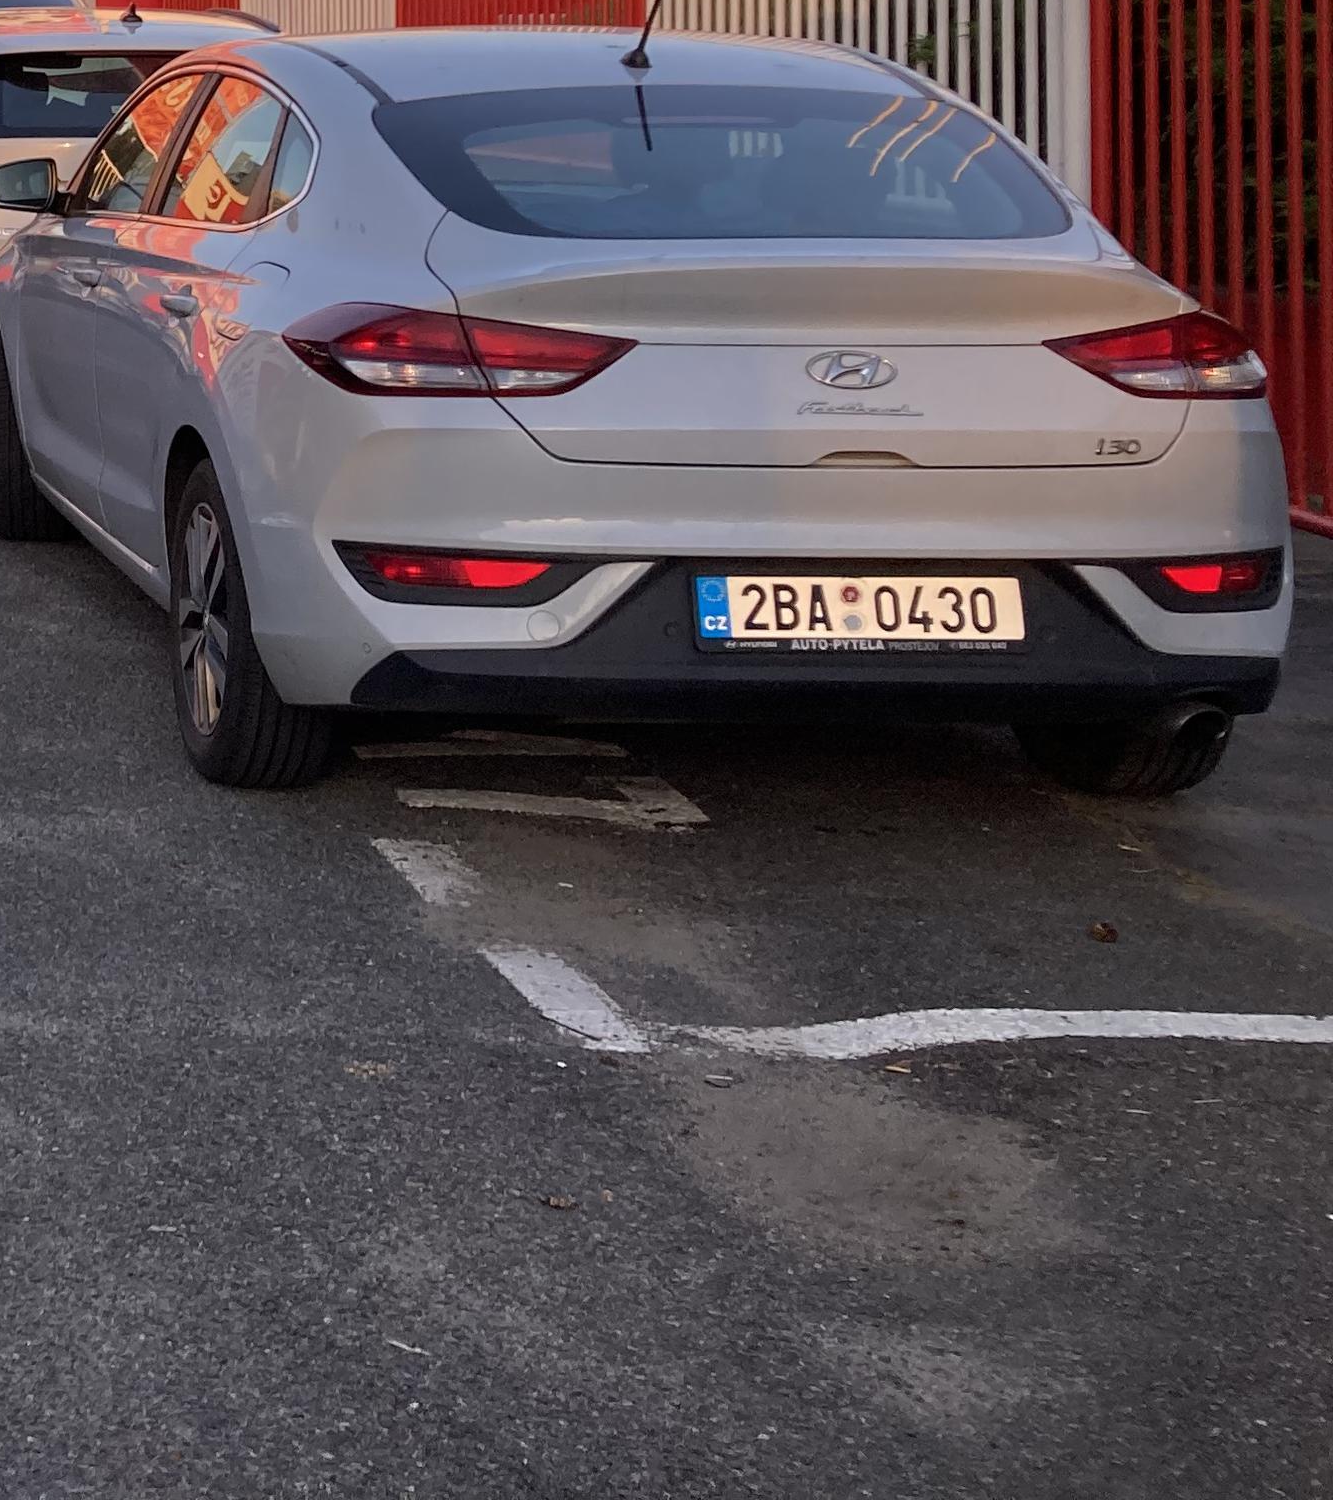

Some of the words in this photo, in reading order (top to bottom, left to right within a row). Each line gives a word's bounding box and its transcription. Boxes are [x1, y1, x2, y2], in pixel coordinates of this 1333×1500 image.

[740, 582, 834, 632] 2BA
[874, 585, 998, 634] 0430
[704, 614, 729, 631] CZ
[790, 638, 885, 651] AUTO-PYTELA
